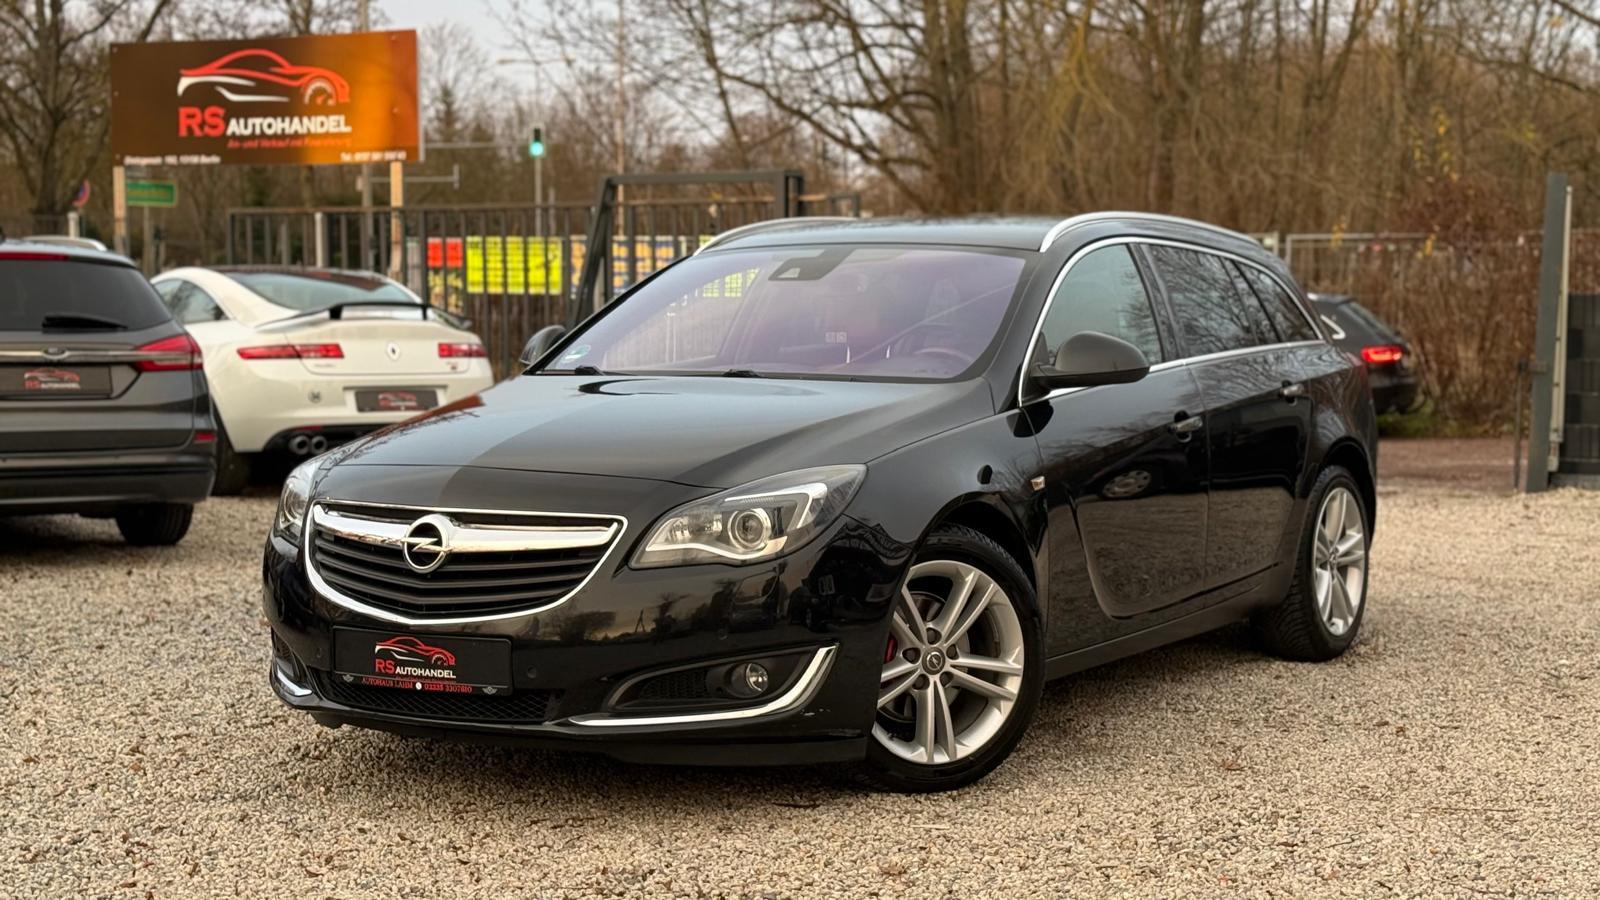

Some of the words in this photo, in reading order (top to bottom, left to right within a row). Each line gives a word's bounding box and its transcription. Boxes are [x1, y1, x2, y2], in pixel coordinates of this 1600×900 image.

[178, 106, 226, 137] RS
[226, 115, 352, 136] AUTOHANDEL
[375, 659, 395, 674] RS
[395, 666, 456, 679] AUTOHANDEL
[361, 677, 394, 687] AUTOHAUS
